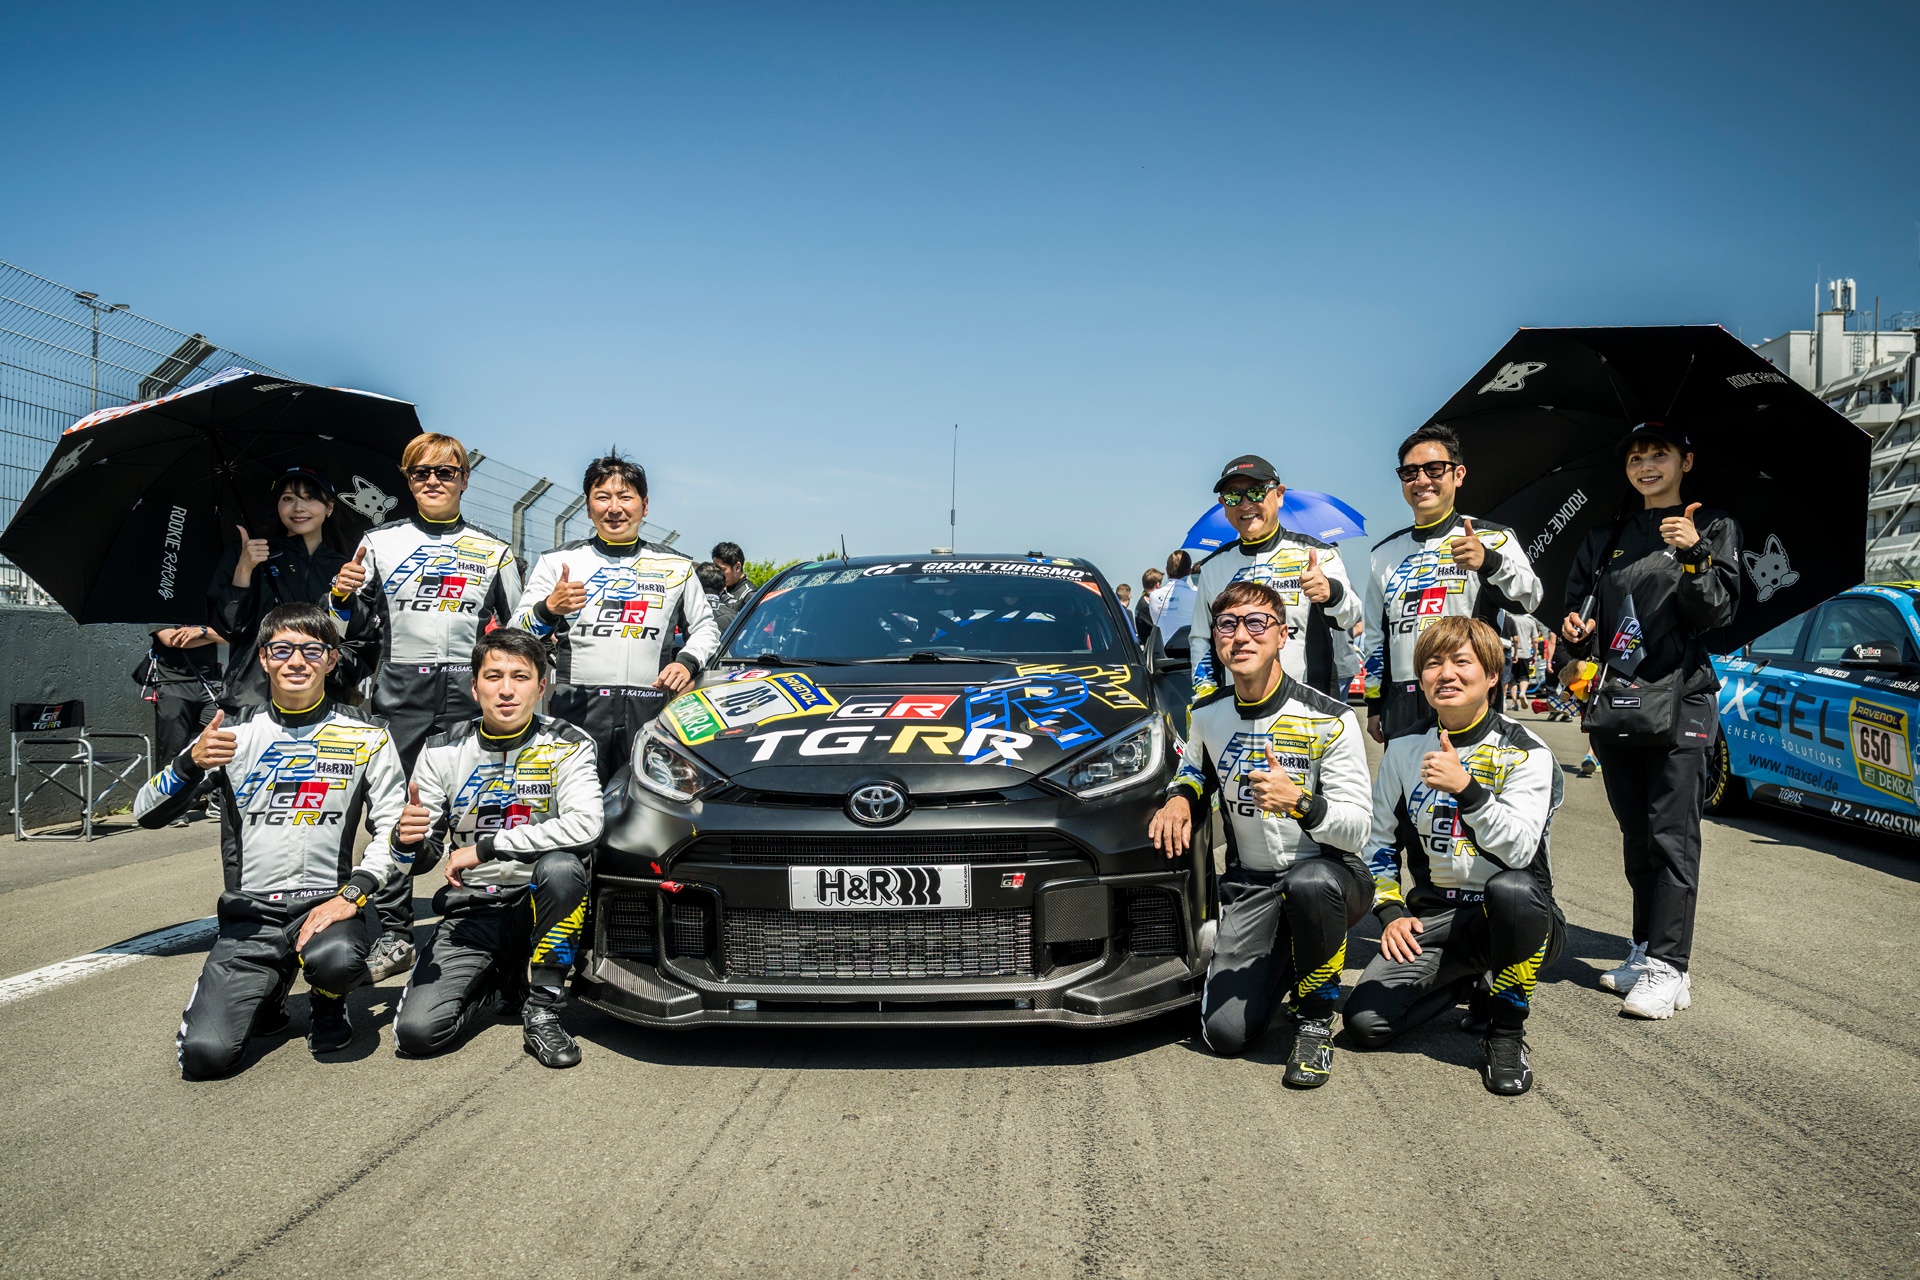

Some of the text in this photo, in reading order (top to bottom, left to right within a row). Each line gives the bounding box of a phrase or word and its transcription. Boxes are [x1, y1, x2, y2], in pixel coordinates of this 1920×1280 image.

[1526, 488, 1588, 564] ROOKIE RACI
[158, 505, 187, 601] ROOKIE RACING
[458, 561, 476, 572] H&R
[922, 562, 1085, 578] GRAN TURISMO
[1021, 572, 1082, 582] SIMULATOR
[1272, 580, 1290, 589] H&R
[417, 583, 463, 599] GR
[637, 583, 655, 591] H&R
[396, 599, 478, 614] TG-RR
[599, 607, 646, 623] GR
[1402, 596, 1444, 616] GR
[577, 624, 660, 640] TG-RR
[1389, 616, 1446, 636] TG-R
[780, 676, 819, 705] RAVENOL
[834, 699, 953, 719] GR
[1857, 706, 1898, 724] RAVENOL
[674, 701, 714, 738] DEKRA
[321, 746, 354, 754] RAVENOL
[744, 725, 1034, 763] TG-RR
[1727, 724, 1842, 769] ENERGY SOLUTIONS
[1860, 726, 1891, 766] 650
[316, 762, 341, 774] H&R
[1749, 753, 1839, 795] www.maxsel.de
[517, 784, 538, 795] H&R
[1879, 771, 1914, 798] DEKRA
[270, 790, 325, 808] GR
[246, 811, 343, 826] TG-RR
[818, 869, 897, 905] H&R
[1001, 878, 1024, 887] GR
